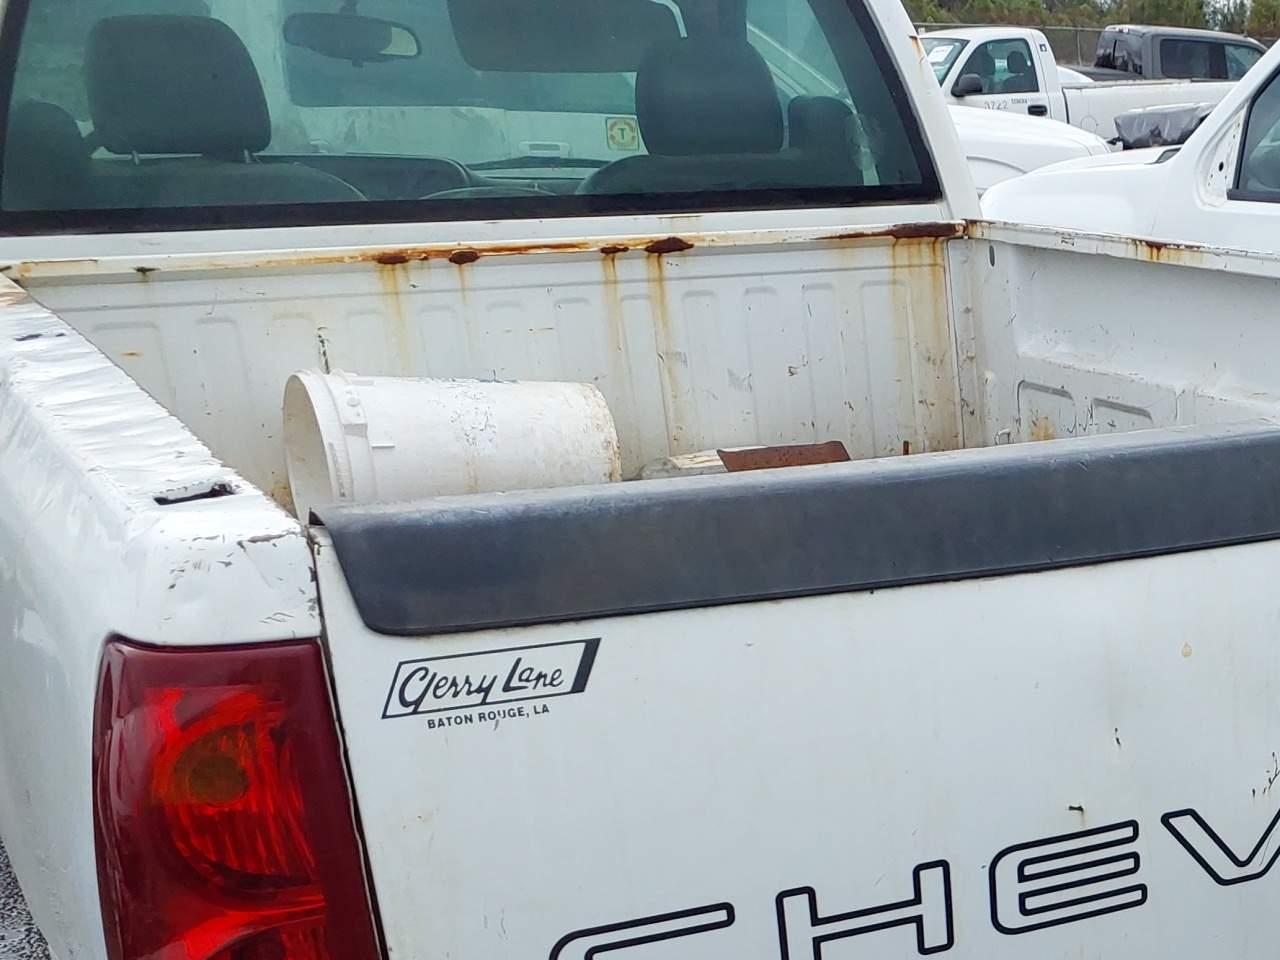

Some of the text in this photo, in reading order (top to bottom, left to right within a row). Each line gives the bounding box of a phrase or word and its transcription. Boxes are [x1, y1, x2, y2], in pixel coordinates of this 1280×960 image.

[398, 657, 564, 713] Gerry Lane
[427, 704, 550, 729] BATON ROUGE, LA
